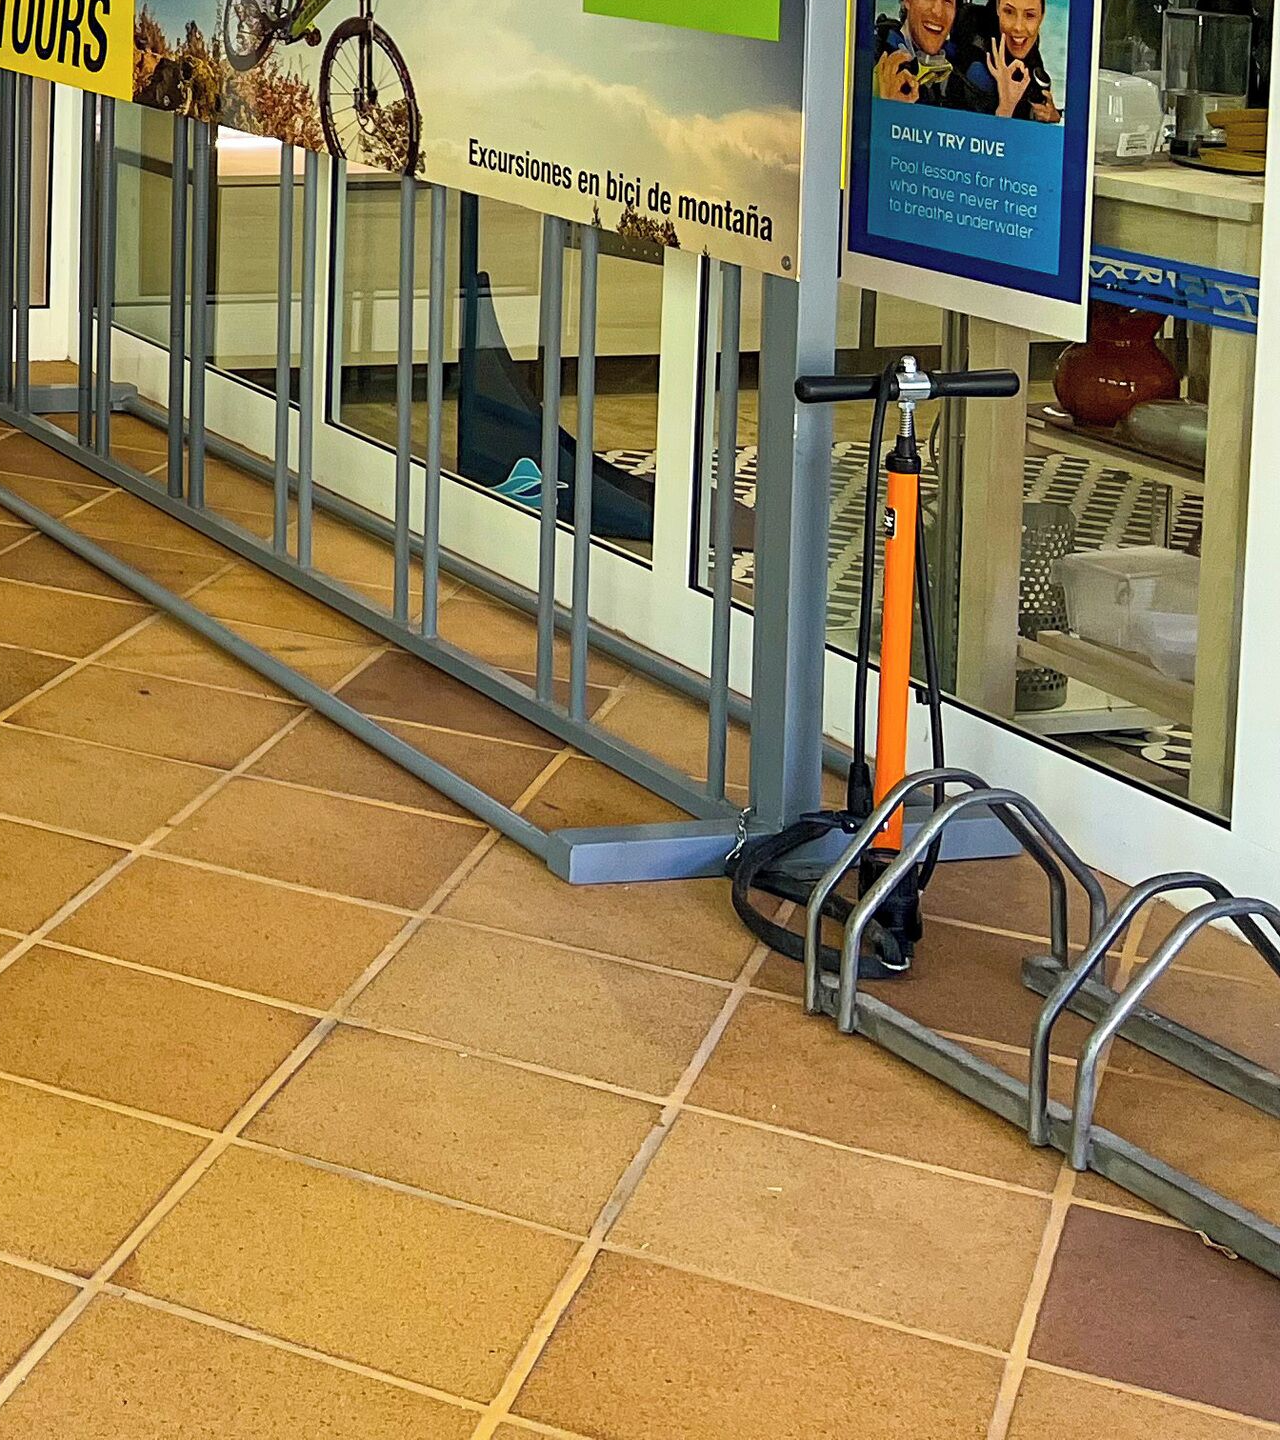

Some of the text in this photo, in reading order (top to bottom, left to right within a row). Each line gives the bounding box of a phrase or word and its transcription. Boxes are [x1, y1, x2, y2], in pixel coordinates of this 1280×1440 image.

[891, 124, 1005, 157] DAILY TRY DIVE
[468, 137, 773, 242] Excursiones en bici de montaña
[890, 156, 1038, 197] Pool lessons for those
[889, 198, 1034, 239] to breathe underwater
[890, 179, 1038, 218] who have never tried
